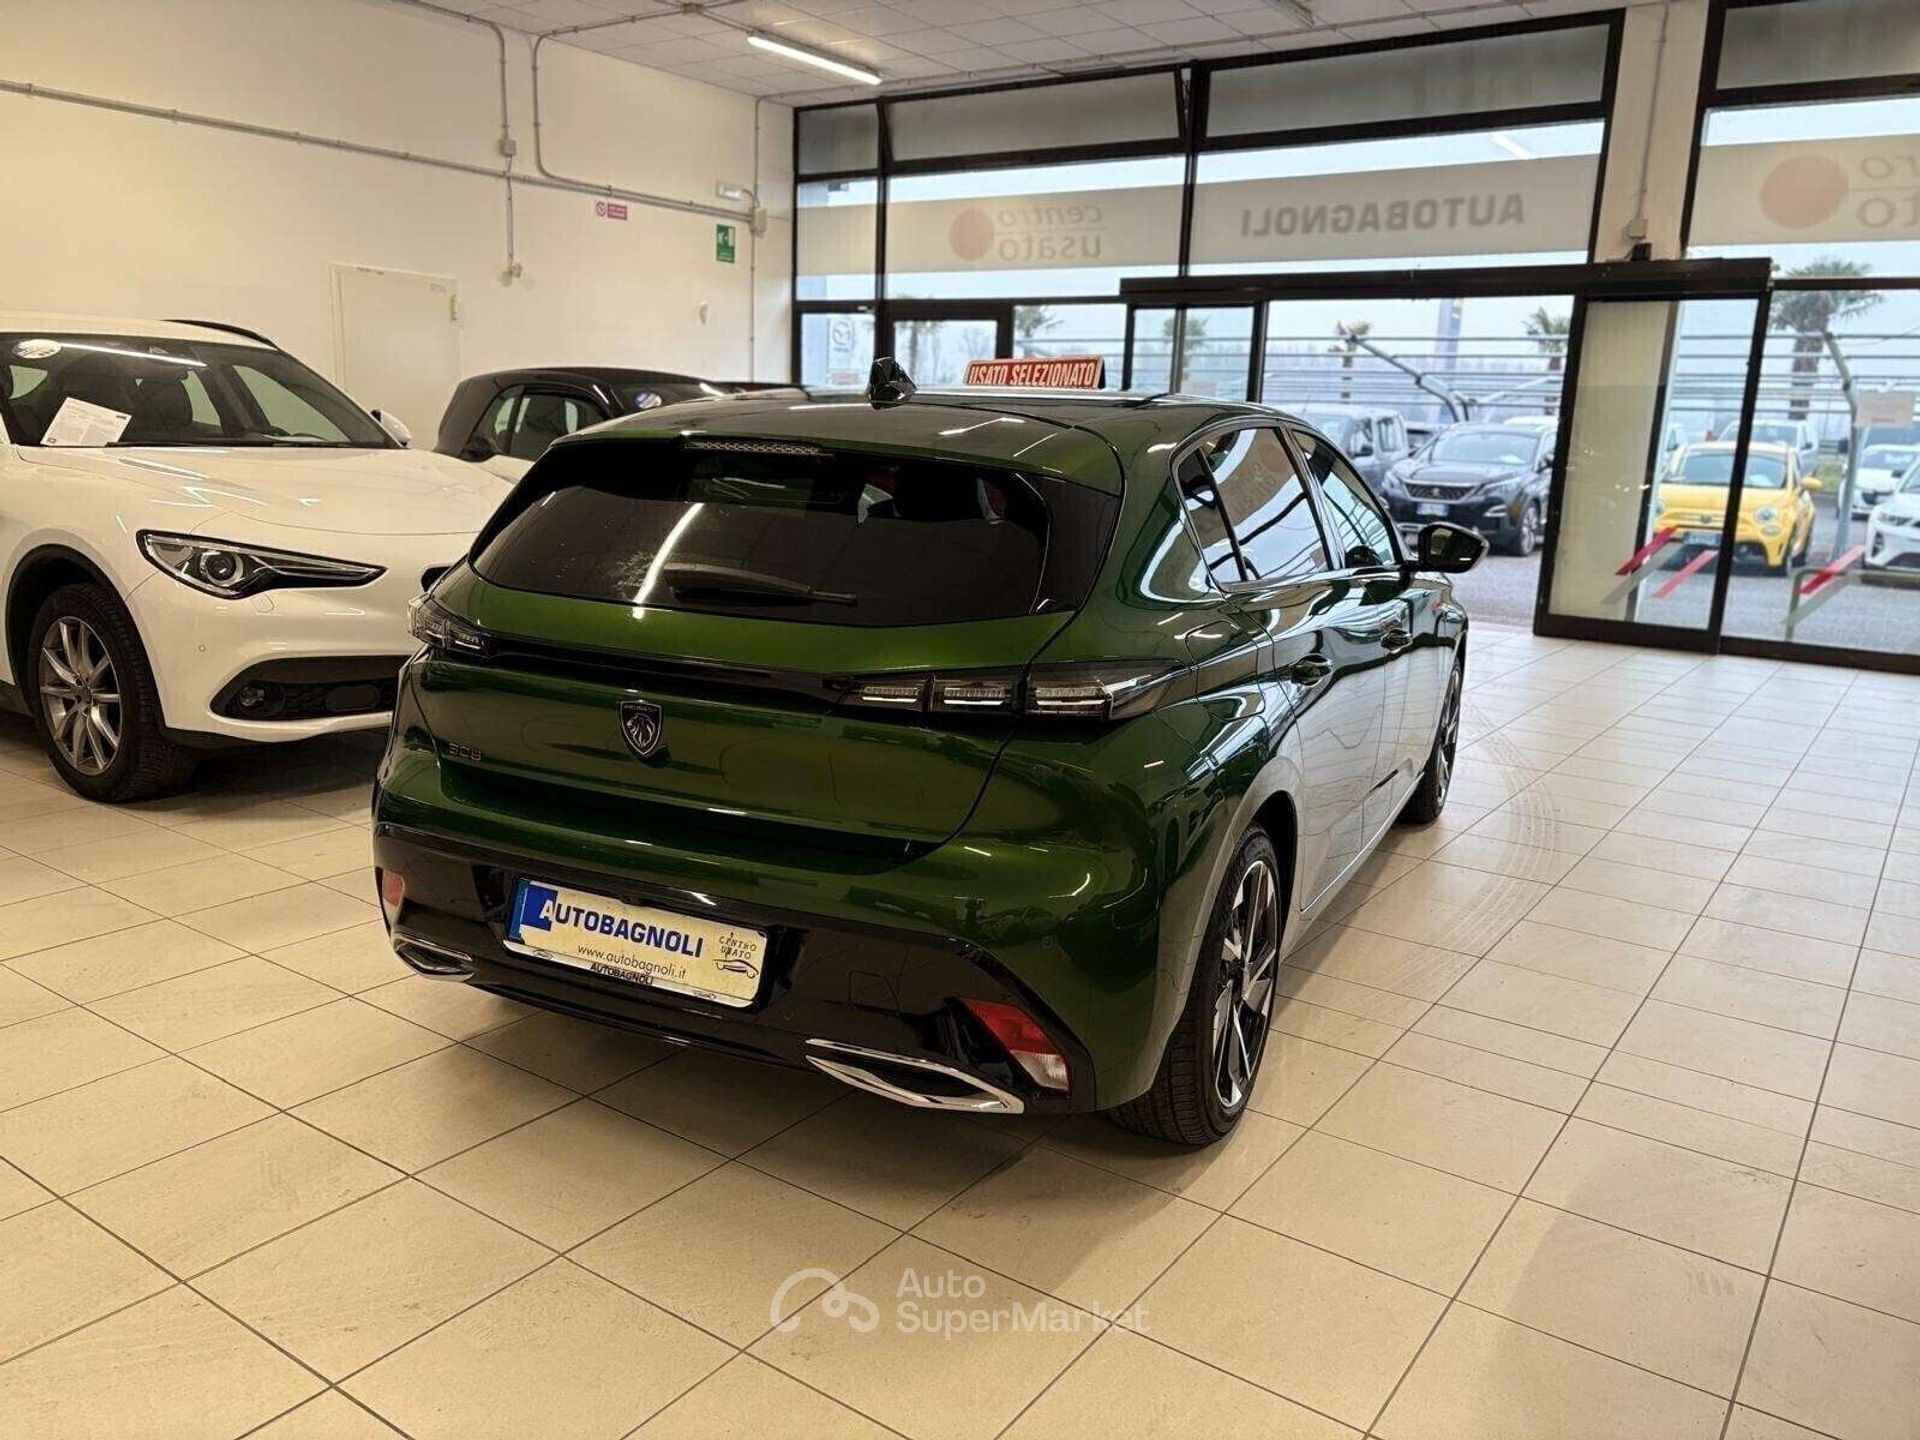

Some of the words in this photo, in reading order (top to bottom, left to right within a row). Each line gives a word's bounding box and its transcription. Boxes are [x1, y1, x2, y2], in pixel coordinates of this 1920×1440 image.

[968, 364, 1009, 385] USATO
[1010, 362, 1096, 388] SELEZIONATO
[539, 899, 704, 958] AUTOBAGNOLI
[577, 944, 687, 979] www.autobagnoli.it
[589, 962, 654, 985] AUTOBAGNOLI
